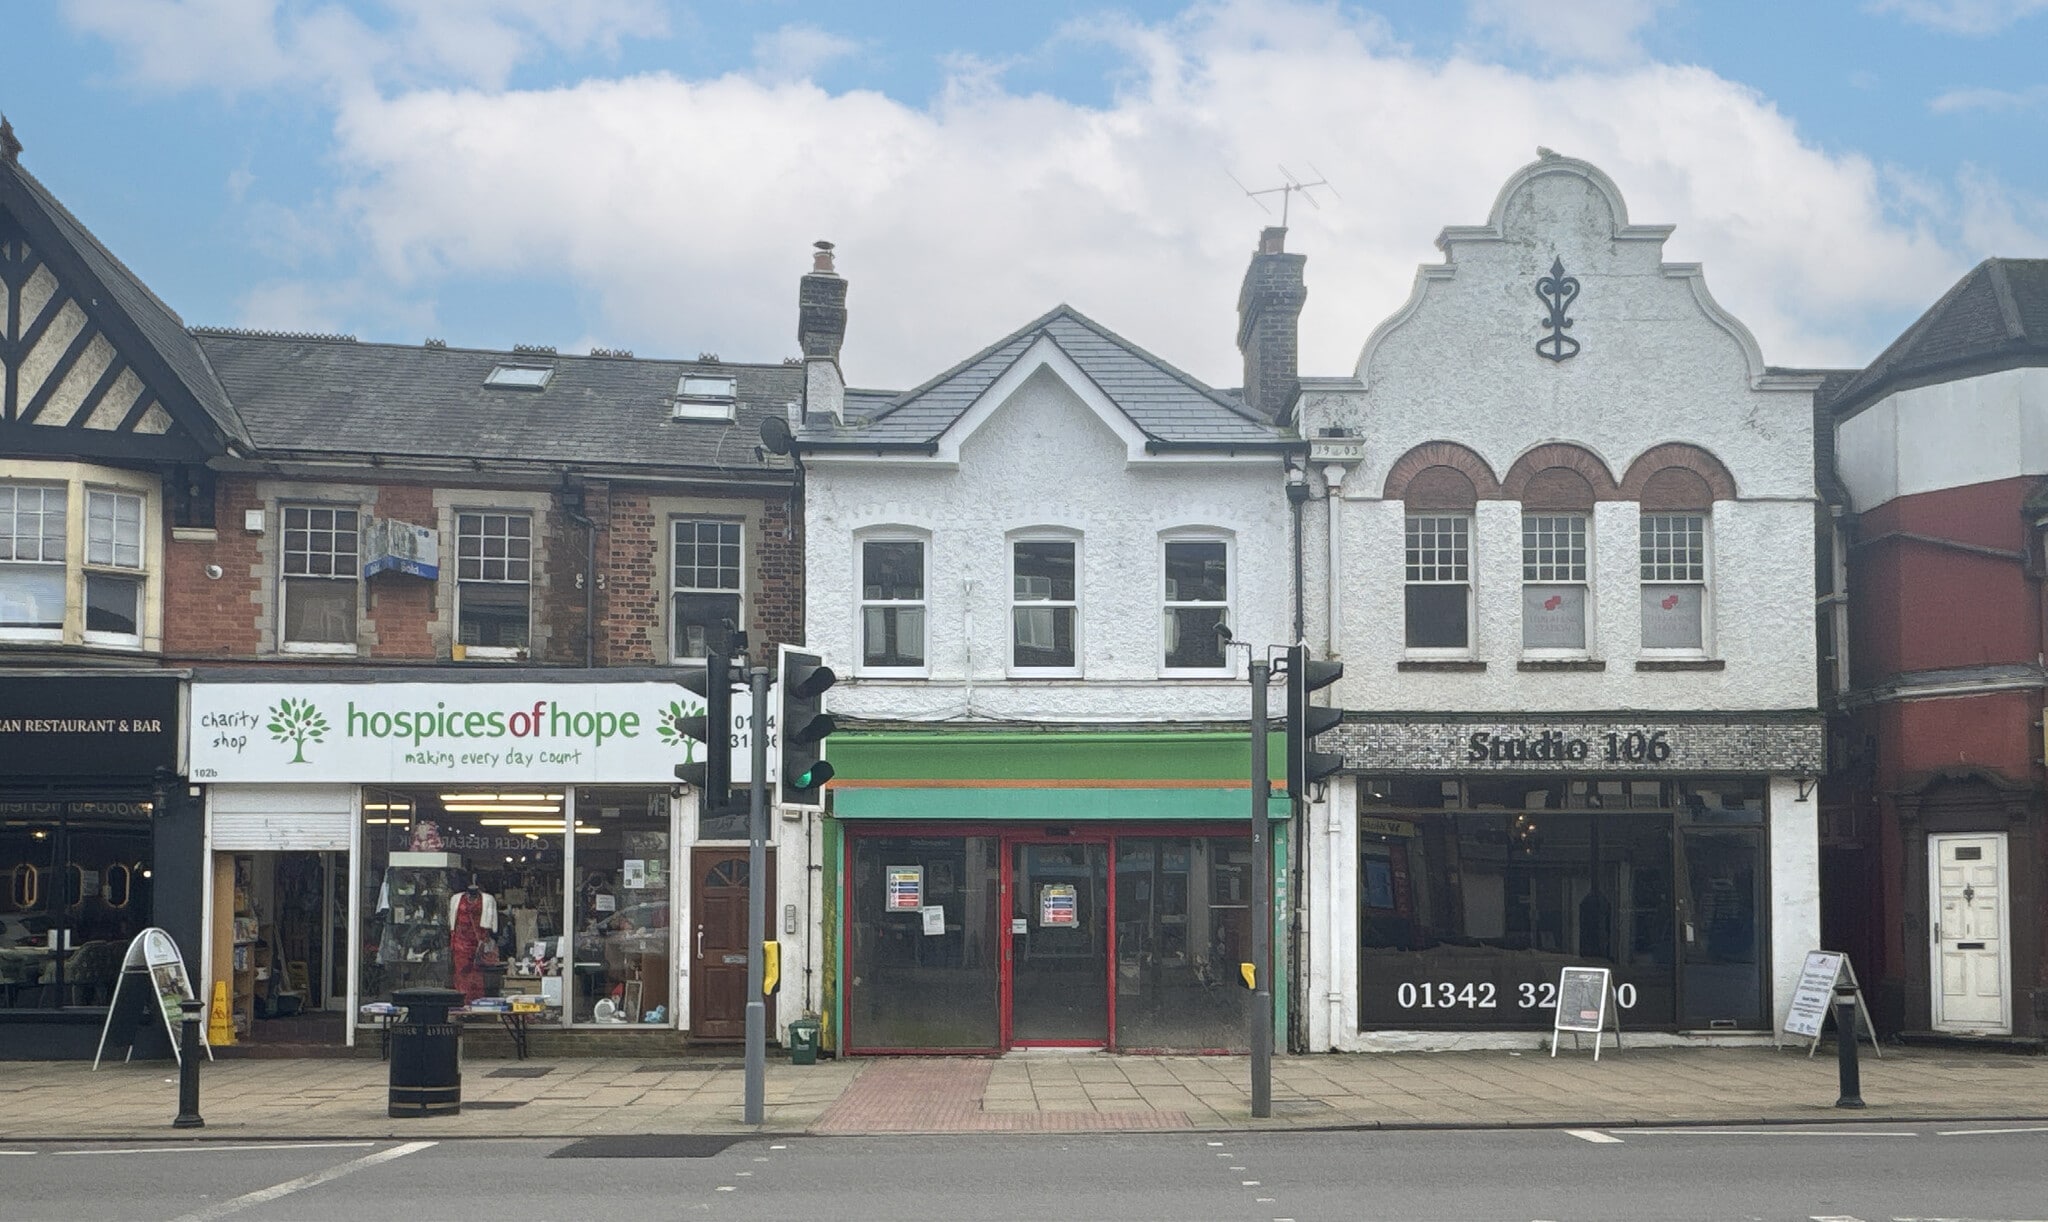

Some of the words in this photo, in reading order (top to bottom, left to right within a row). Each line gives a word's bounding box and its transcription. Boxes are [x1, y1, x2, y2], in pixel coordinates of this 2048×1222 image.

[25, 719, 117, 732] RESTAURANT
[118, 719, 130, 732] &
[132, 719, 162, 733] BAR
[201, 710, 260, 730] charity
[212, 730, 248, 754] shop
[1469, 730, 1588, 762] Studio
[1600, 730, 1671, 763] 106
[405, 750, 455, 768] making
[461, 751, 500, 768] every
[505, 747, 534, 768] day
[194, 768, 218, 778] 102b
[1397, 982, 1497, 1009] 01342
